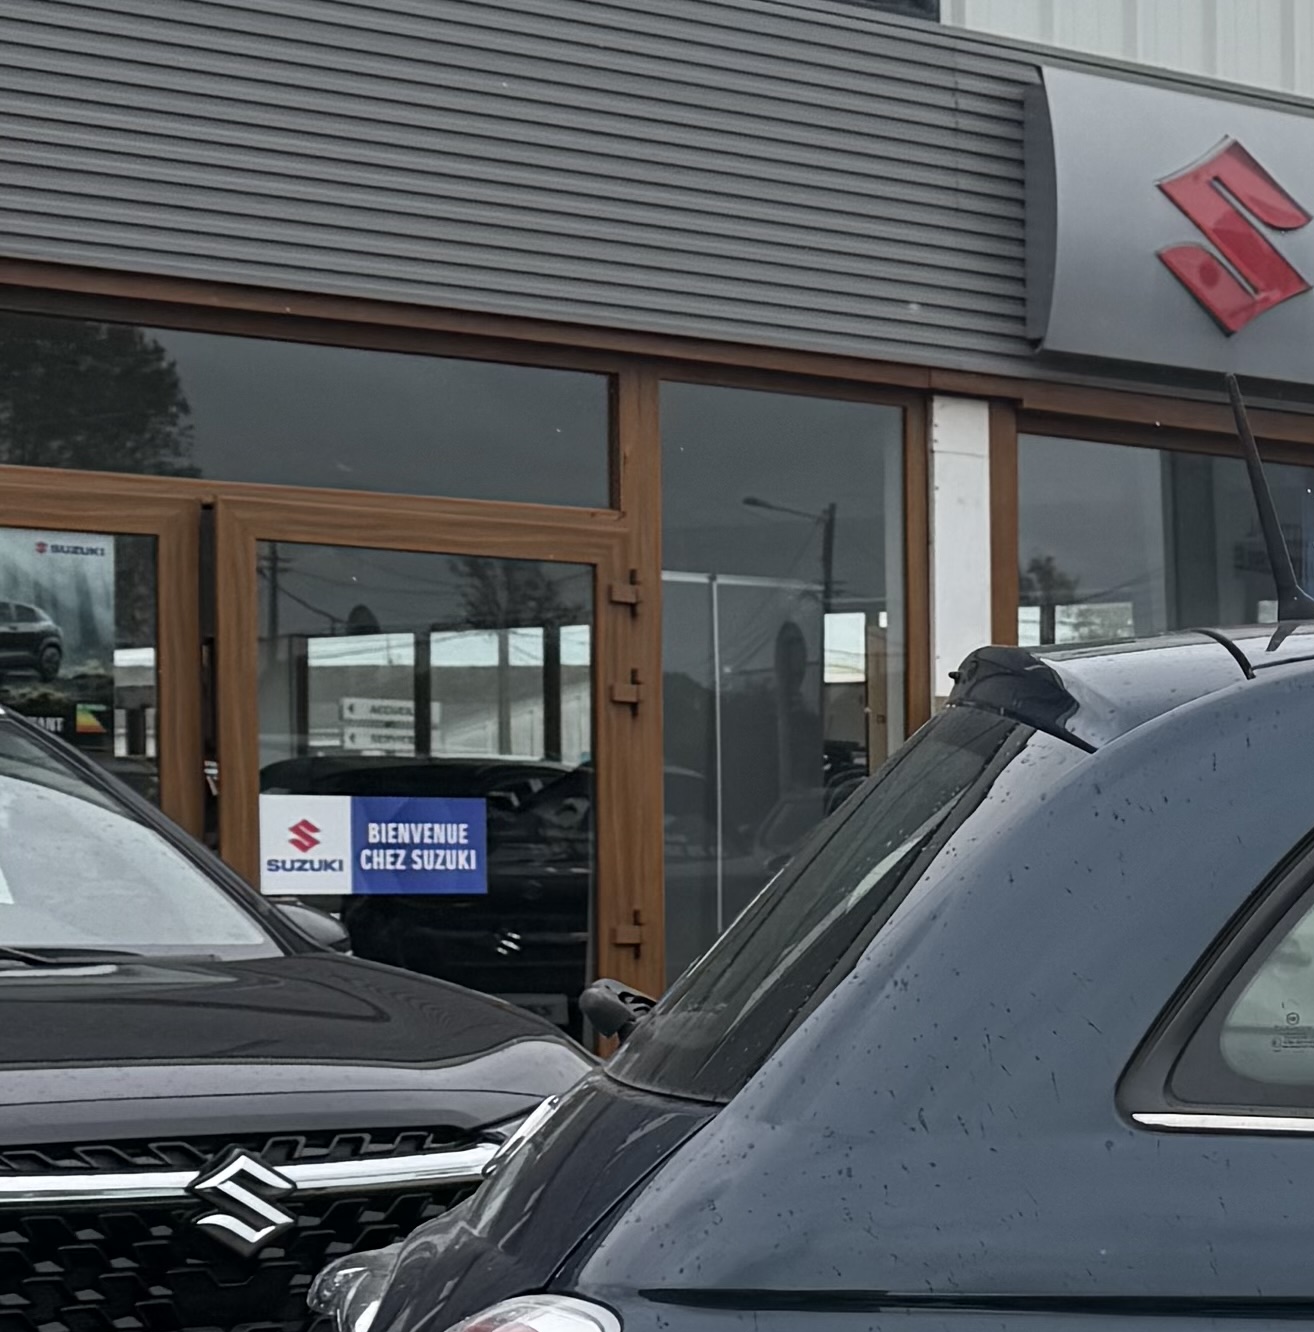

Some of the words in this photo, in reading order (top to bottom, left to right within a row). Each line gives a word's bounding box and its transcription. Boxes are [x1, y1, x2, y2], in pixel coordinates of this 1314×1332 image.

[367, 822, 470, 845] BIENVENUE
[266, 858, 344, 873] SUZUKI
[359, 848, 407, 871] CHEZ
[411, 848, 478, 871] SUZUKI
